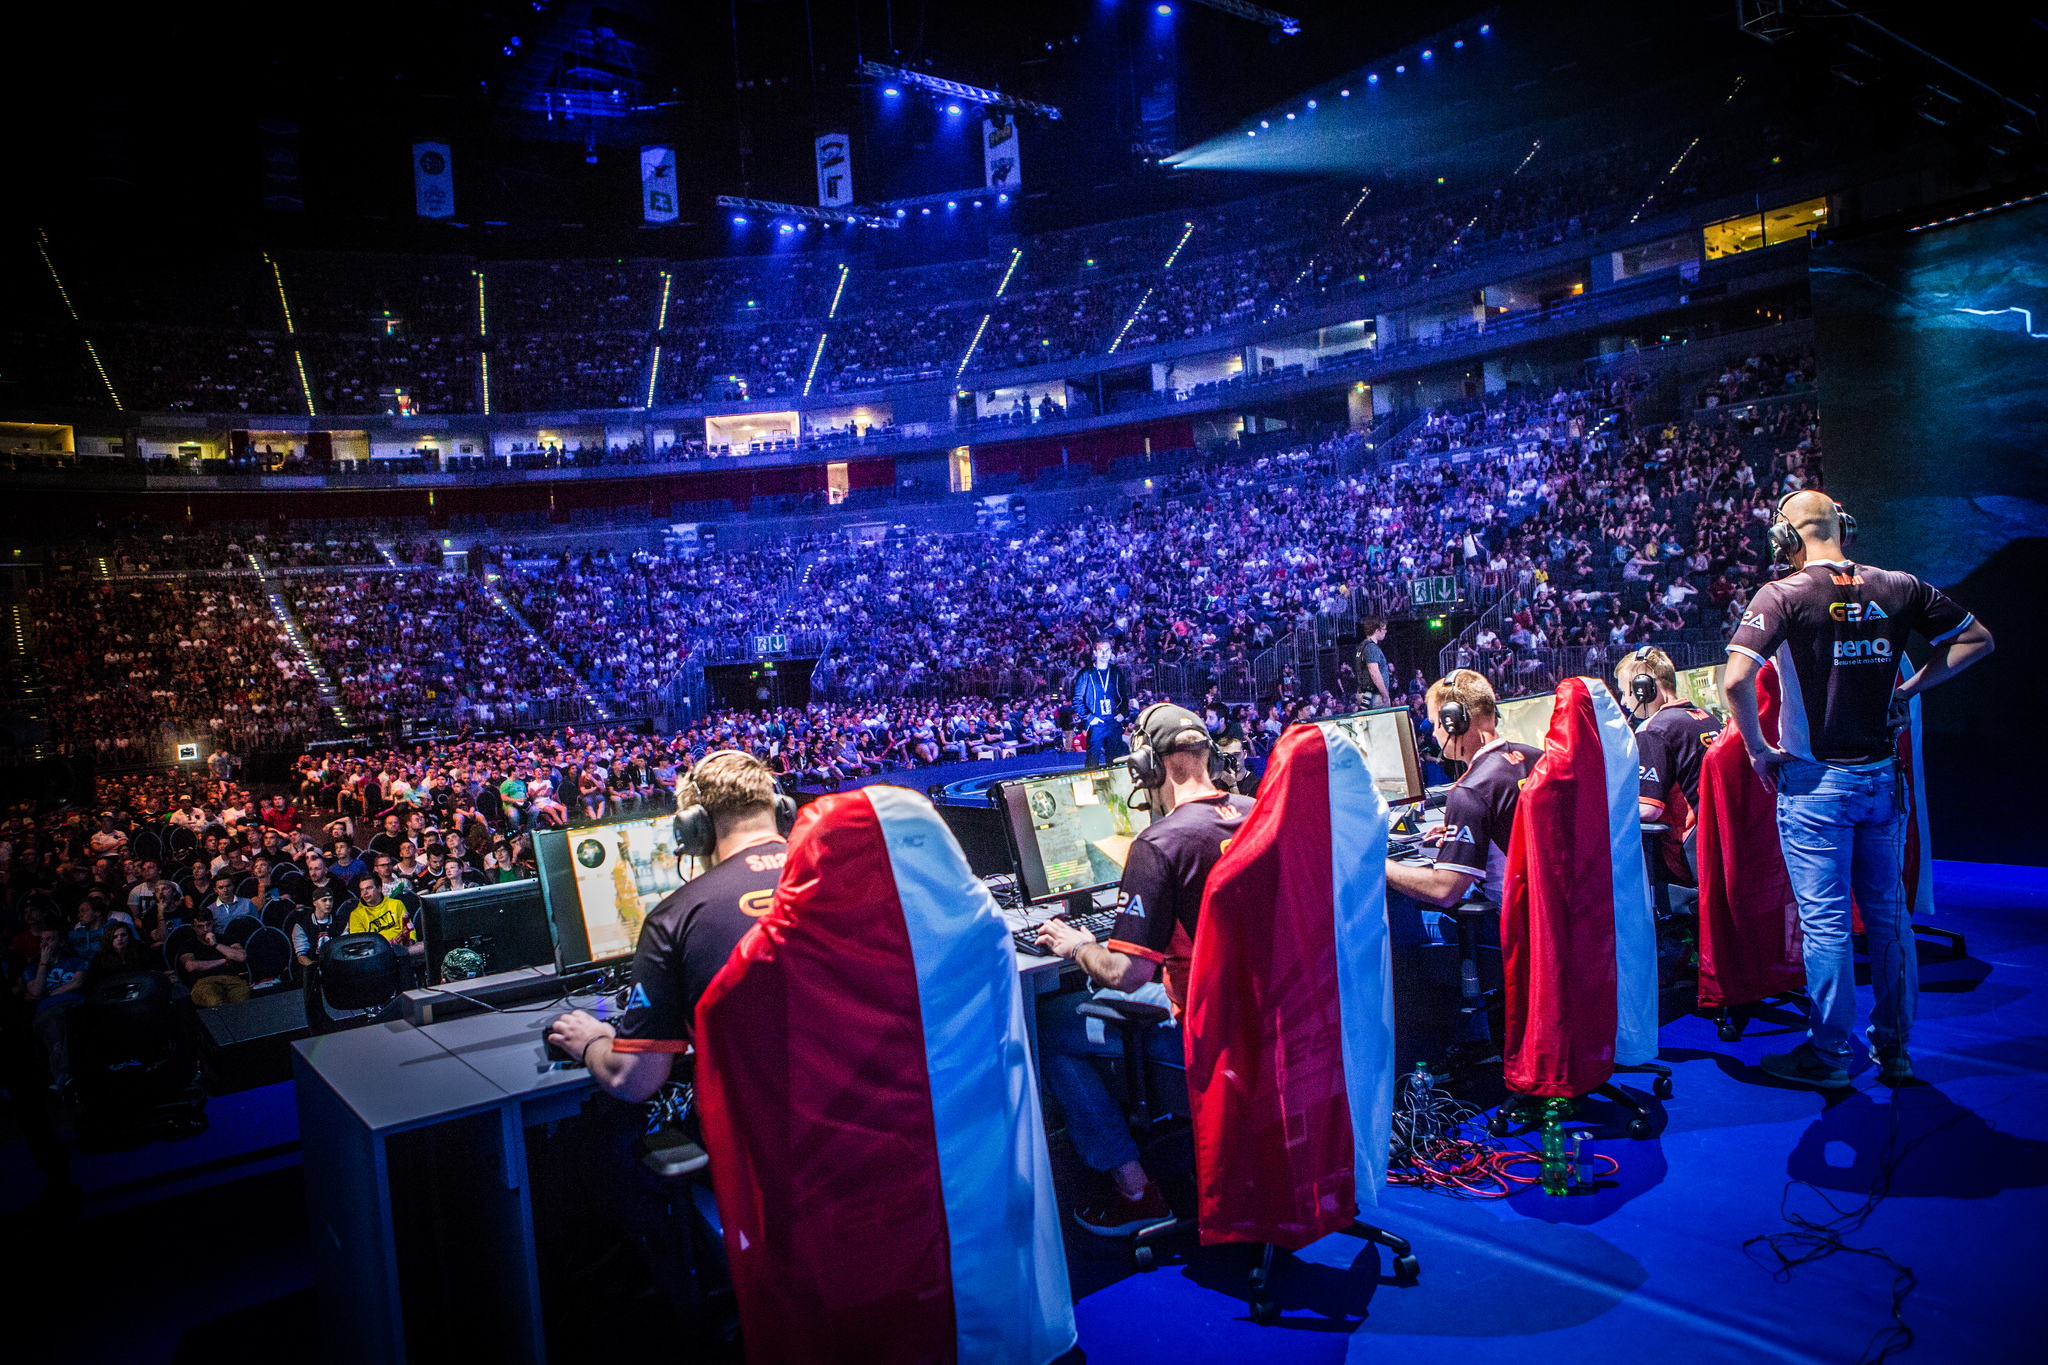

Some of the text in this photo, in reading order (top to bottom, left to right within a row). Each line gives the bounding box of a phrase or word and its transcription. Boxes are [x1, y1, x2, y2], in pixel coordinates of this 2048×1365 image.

[1740, 610, 1765, 631] 2A
[1829, 601, 1889, 622] G2A
[1833, 638, 1892, 657] BenQ
[1638, 765, 1660, 783] 2A
[1443, 824, 1475, 844] 2A
[745, 852, 788, 872] Sna
[1115, 891, 1146, 918] 2A
